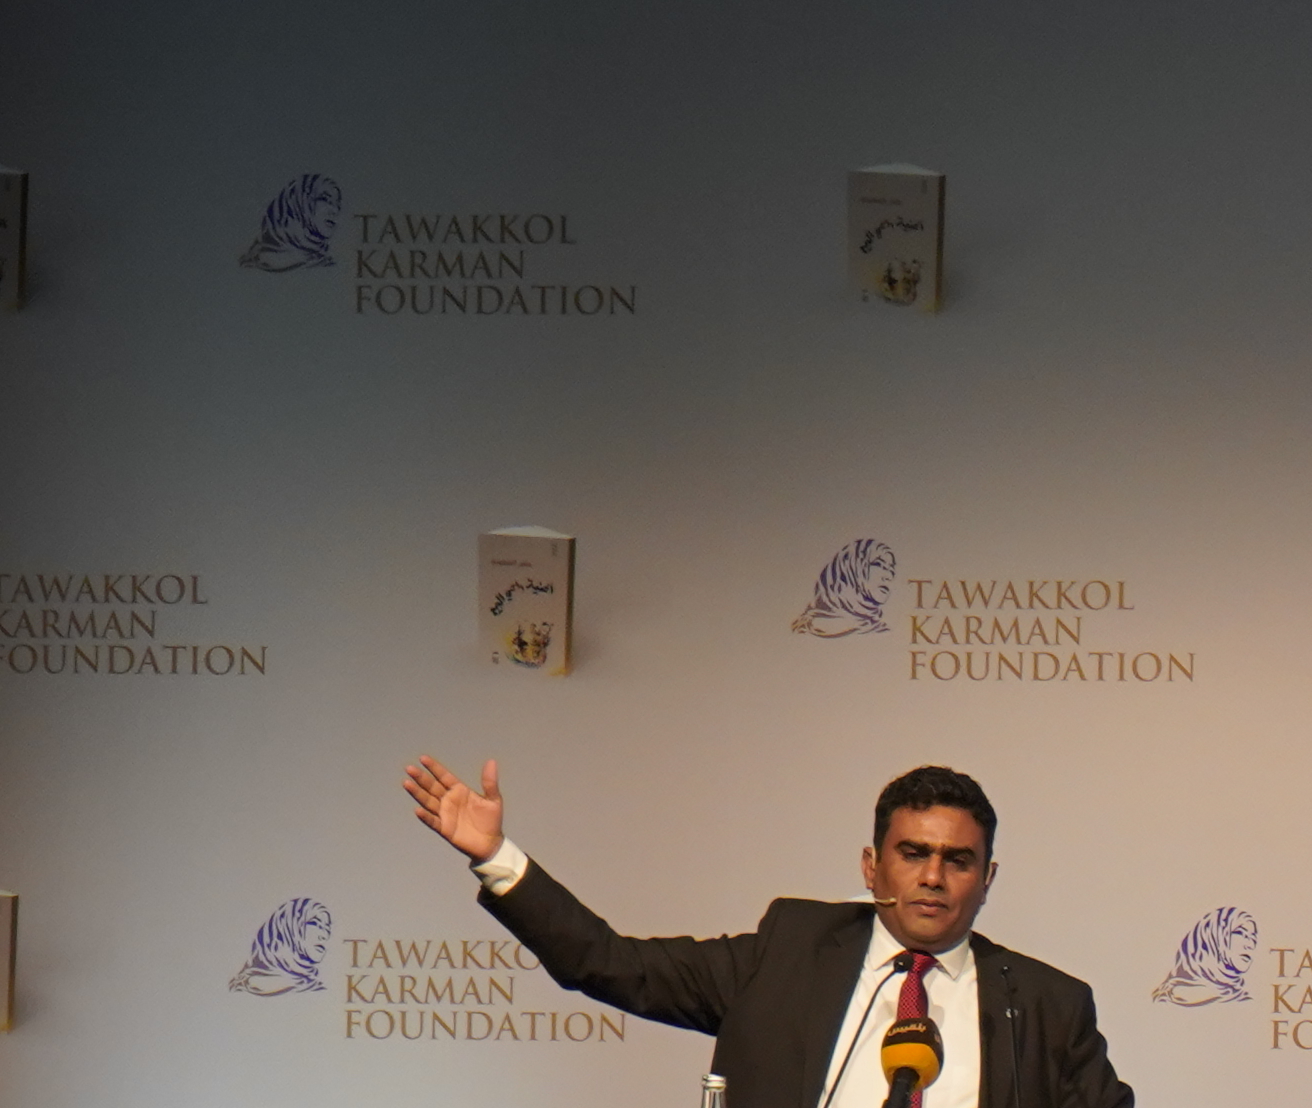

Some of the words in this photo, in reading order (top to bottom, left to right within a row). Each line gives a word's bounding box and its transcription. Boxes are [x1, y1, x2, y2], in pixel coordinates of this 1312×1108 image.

[353, 213, 576, 245] TAWAKKOL
[356, 249, 525, 280] KARMAN
[355, 283, 637, 316] FOUNDATION
[907, 579, 1135, 611] TAWAKKOL
[910, 615, 1083, 647] KARMAN
[0, 643, 268, 676] OUNDATION
[910, 650, 1195, 683] FOUNDATION
[342, 938, 539, 971] TAWAKKO
[346, 974, 515, 1005] KARMAN
[345, 1009, 627, 1043] FOUNDATION
